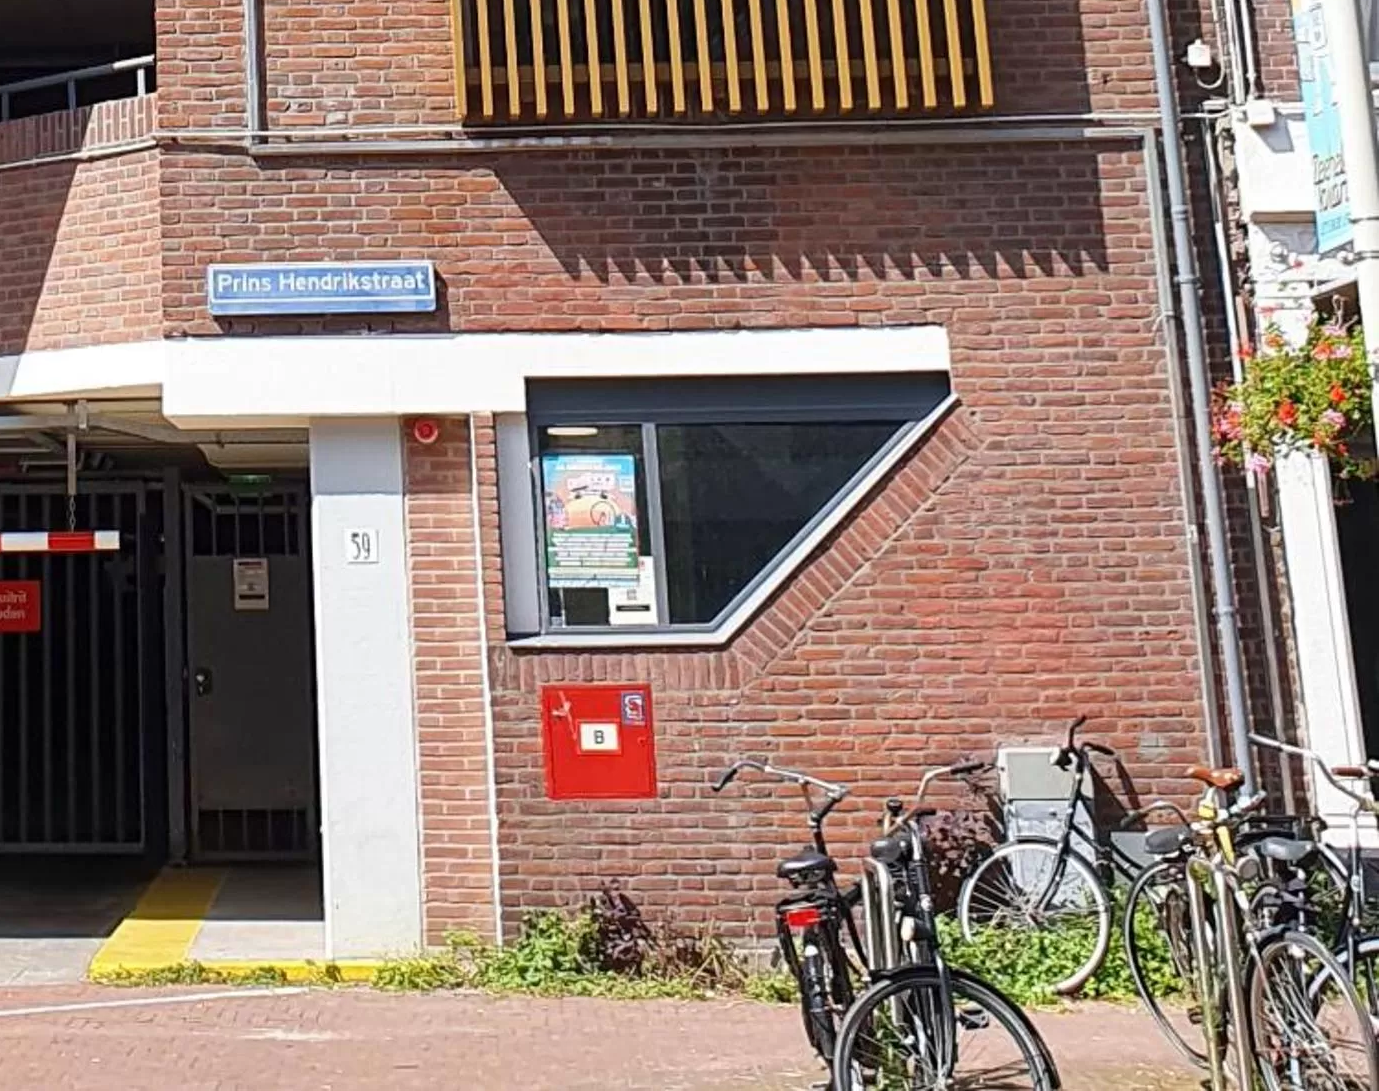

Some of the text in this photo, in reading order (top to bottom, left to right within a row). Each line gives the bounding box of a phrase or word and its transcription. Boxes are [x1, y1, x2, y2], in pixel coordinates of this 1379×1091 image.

[217, 271, 426, 293] Prins Hendrikstraat
[350, 531, 370, 560] 59
[593, 729, 605, 745] B
